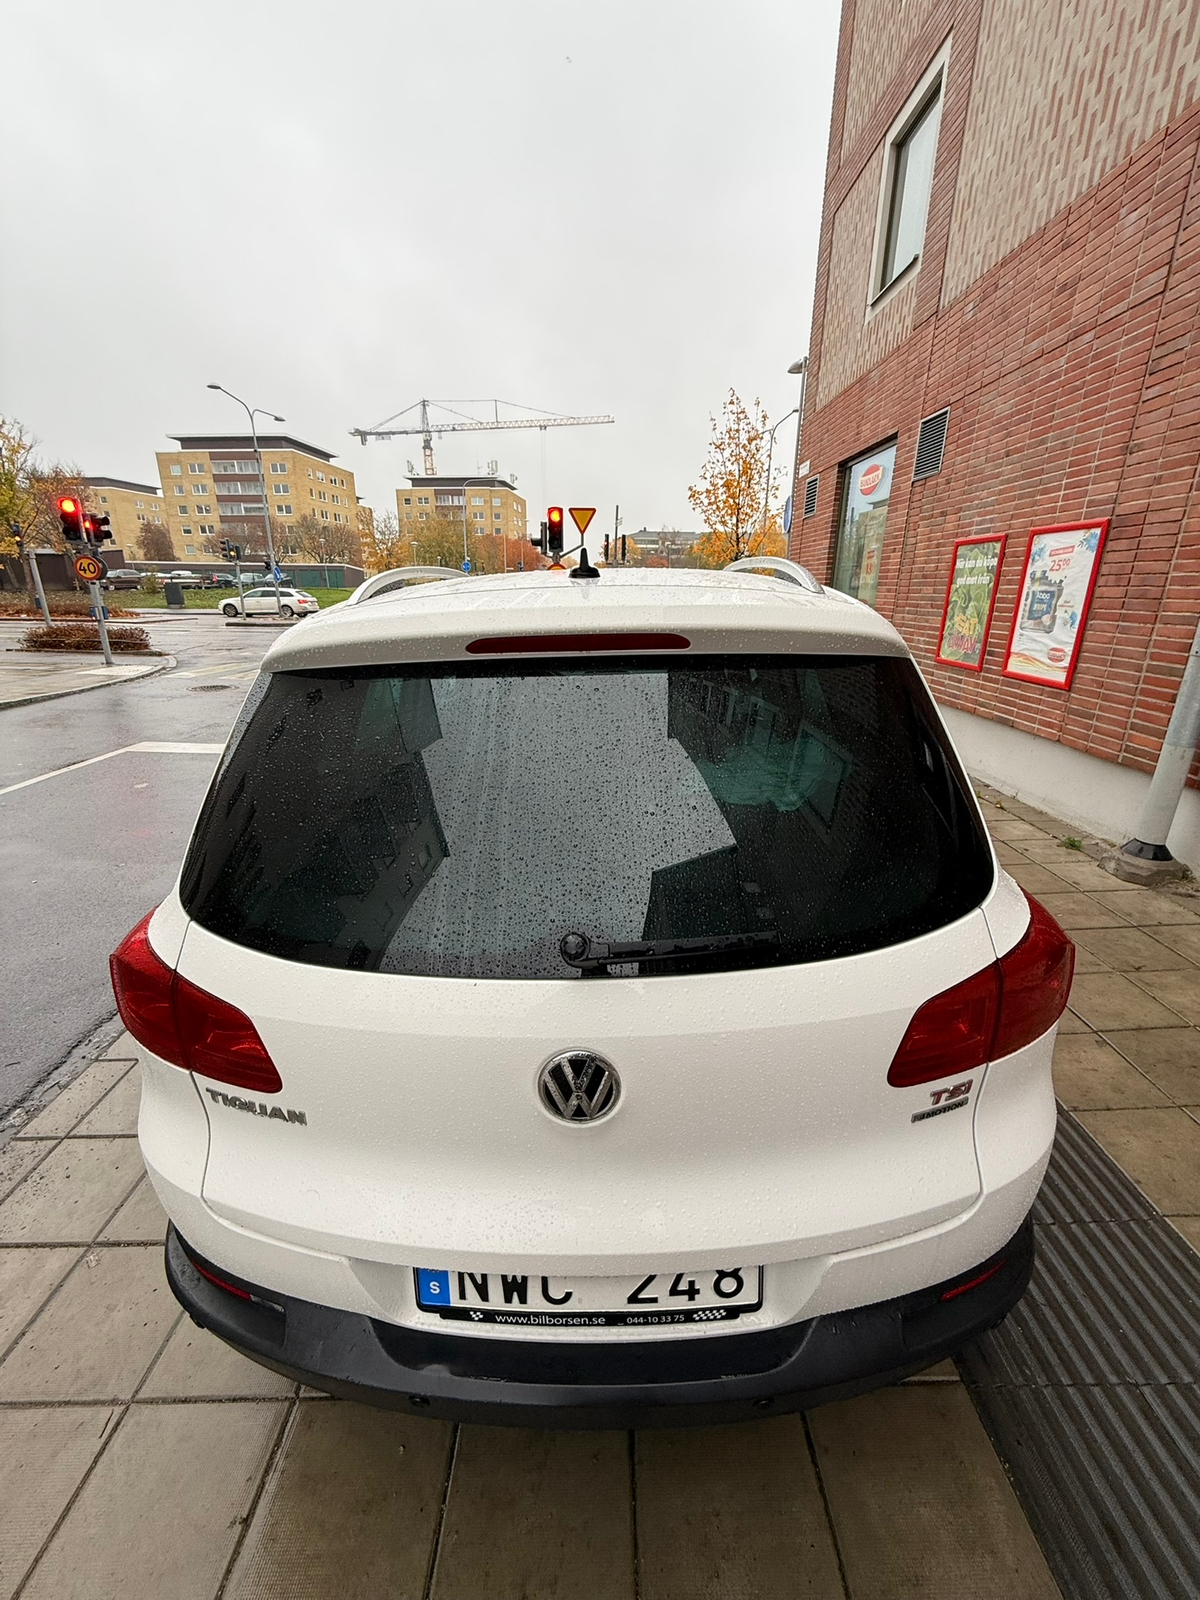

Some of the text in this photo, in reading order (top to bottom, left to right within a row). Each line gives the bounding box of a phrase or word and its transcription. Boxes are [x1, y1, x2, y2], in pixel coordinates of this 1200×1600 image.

[79, 562, 96, 574] 40
[954, 613, 978, 636] EAT
[930, 1078, 974, 1106] TSI
[205, 1087, 307, 1126] TIGUAN
[916, 1100, 965, 1122] 4MOTION
[429, 1281, 441, 1294] S
[457, 1271, 573, 1305] NWC
[495, 1314, 685, 1325] www.bilborsen.se 044-10 33 75
